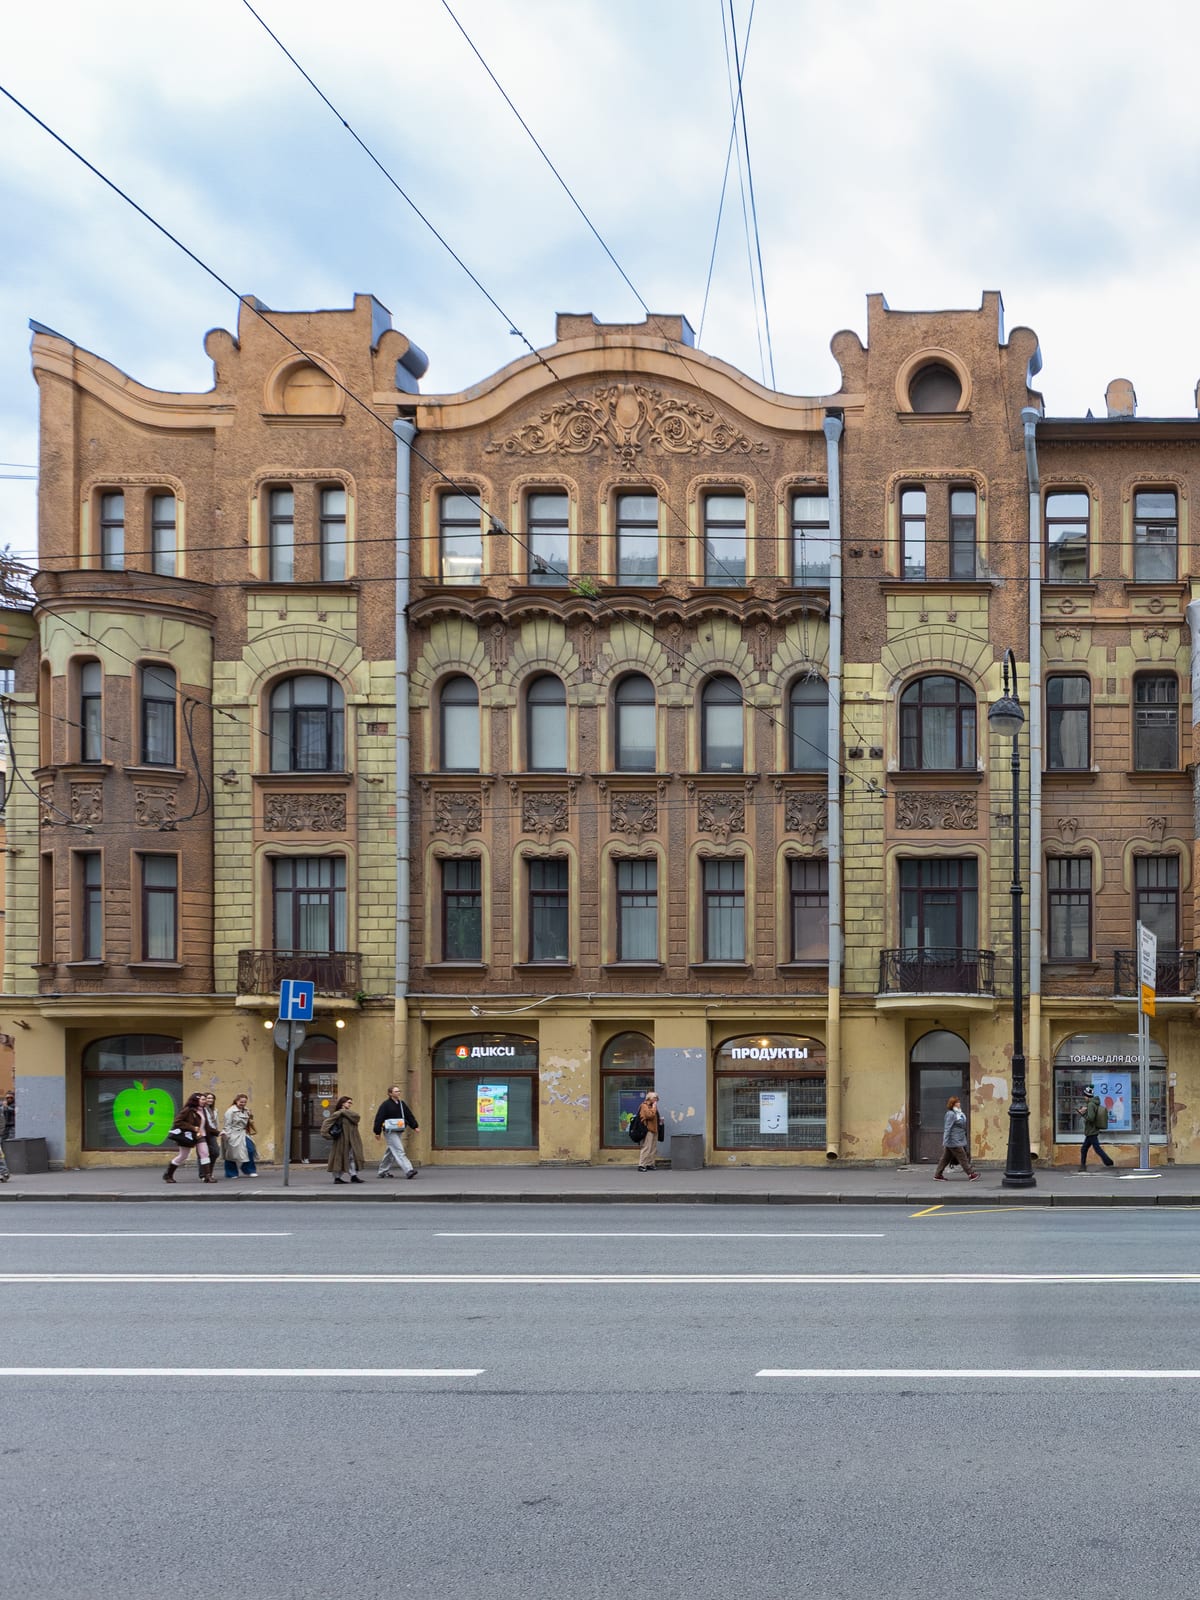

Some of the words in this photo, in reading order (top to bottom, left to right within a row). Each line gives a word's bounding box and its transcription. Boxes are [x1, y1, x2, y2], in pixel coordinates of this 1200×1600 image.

[731, 1047, 808, 1061] ПРОДУКТЫ
[1070, 1055, 1104, 1063] ТОВАРЫ
[1105, 1055, 1124, 1063] ДЛЯ
[1100, 1083, 1108, 1095] 3
[1115, 1083, 1122, 1095] 2
